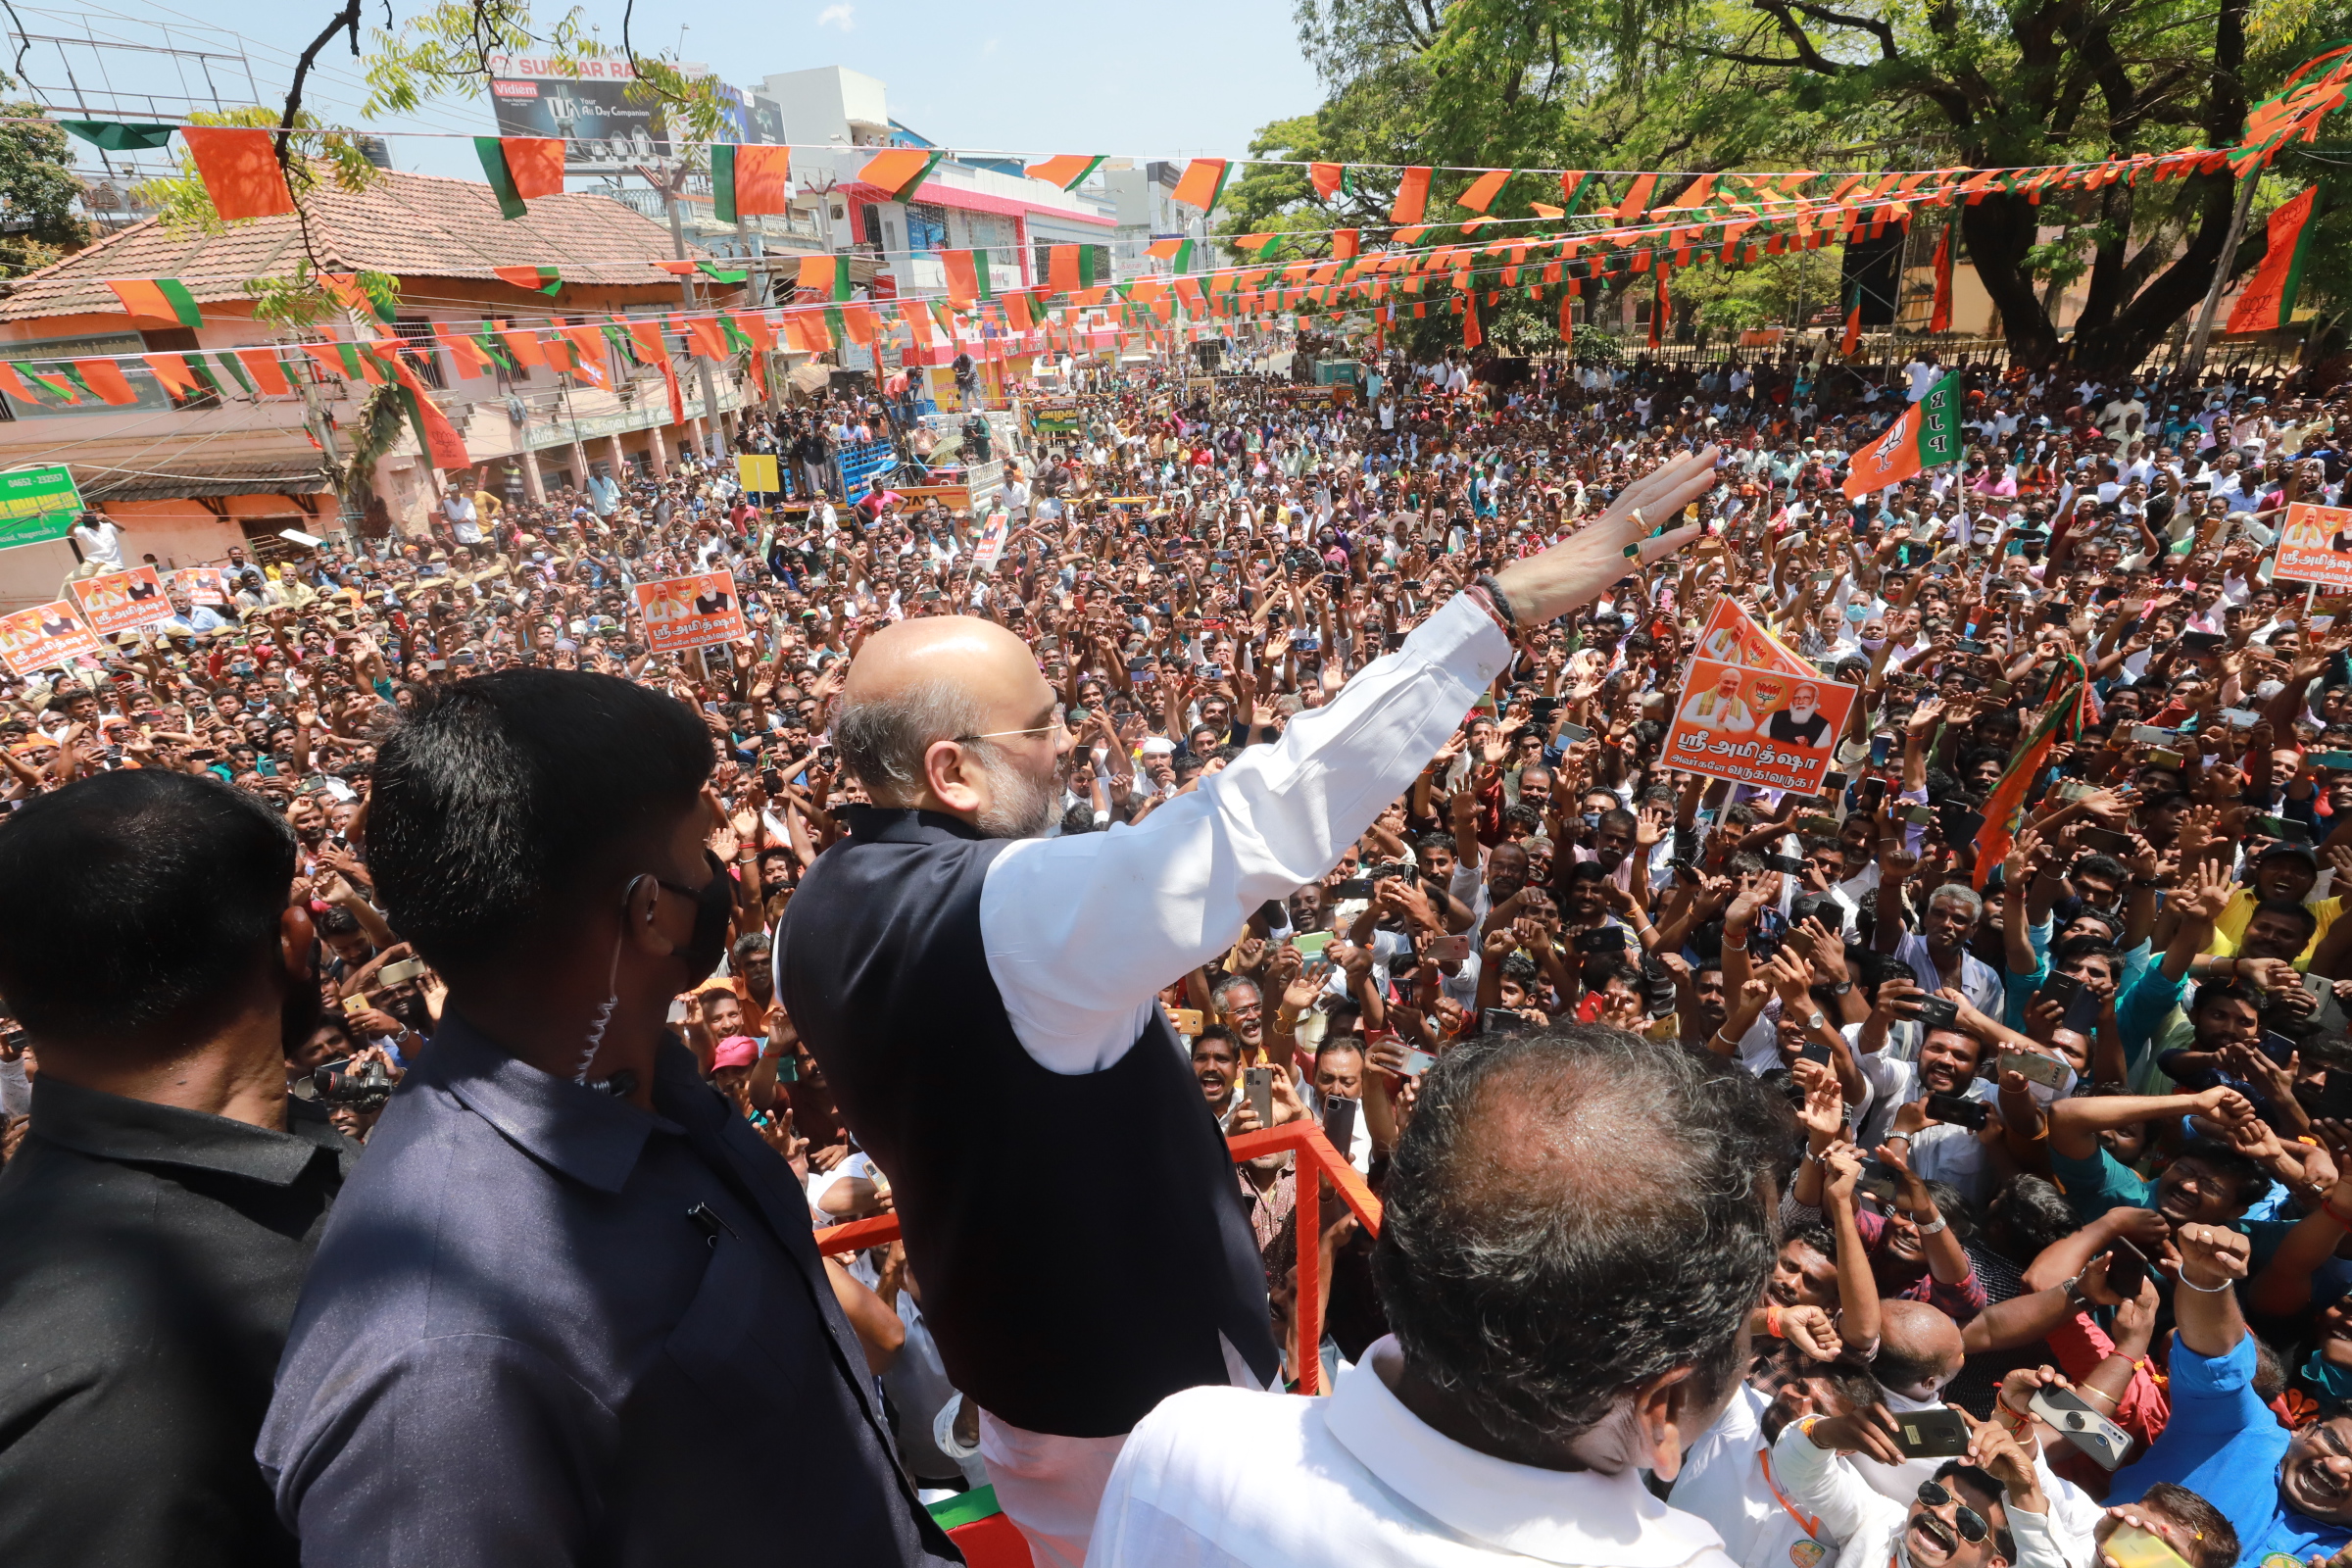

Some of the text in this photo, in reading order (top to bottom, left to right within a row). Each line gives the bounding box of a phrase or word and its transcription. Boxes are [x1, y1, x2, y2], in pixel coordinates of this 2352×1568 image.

[518, 59, 605, 77] SUNAR
[582, 106, 650, 118] All Day Companion
